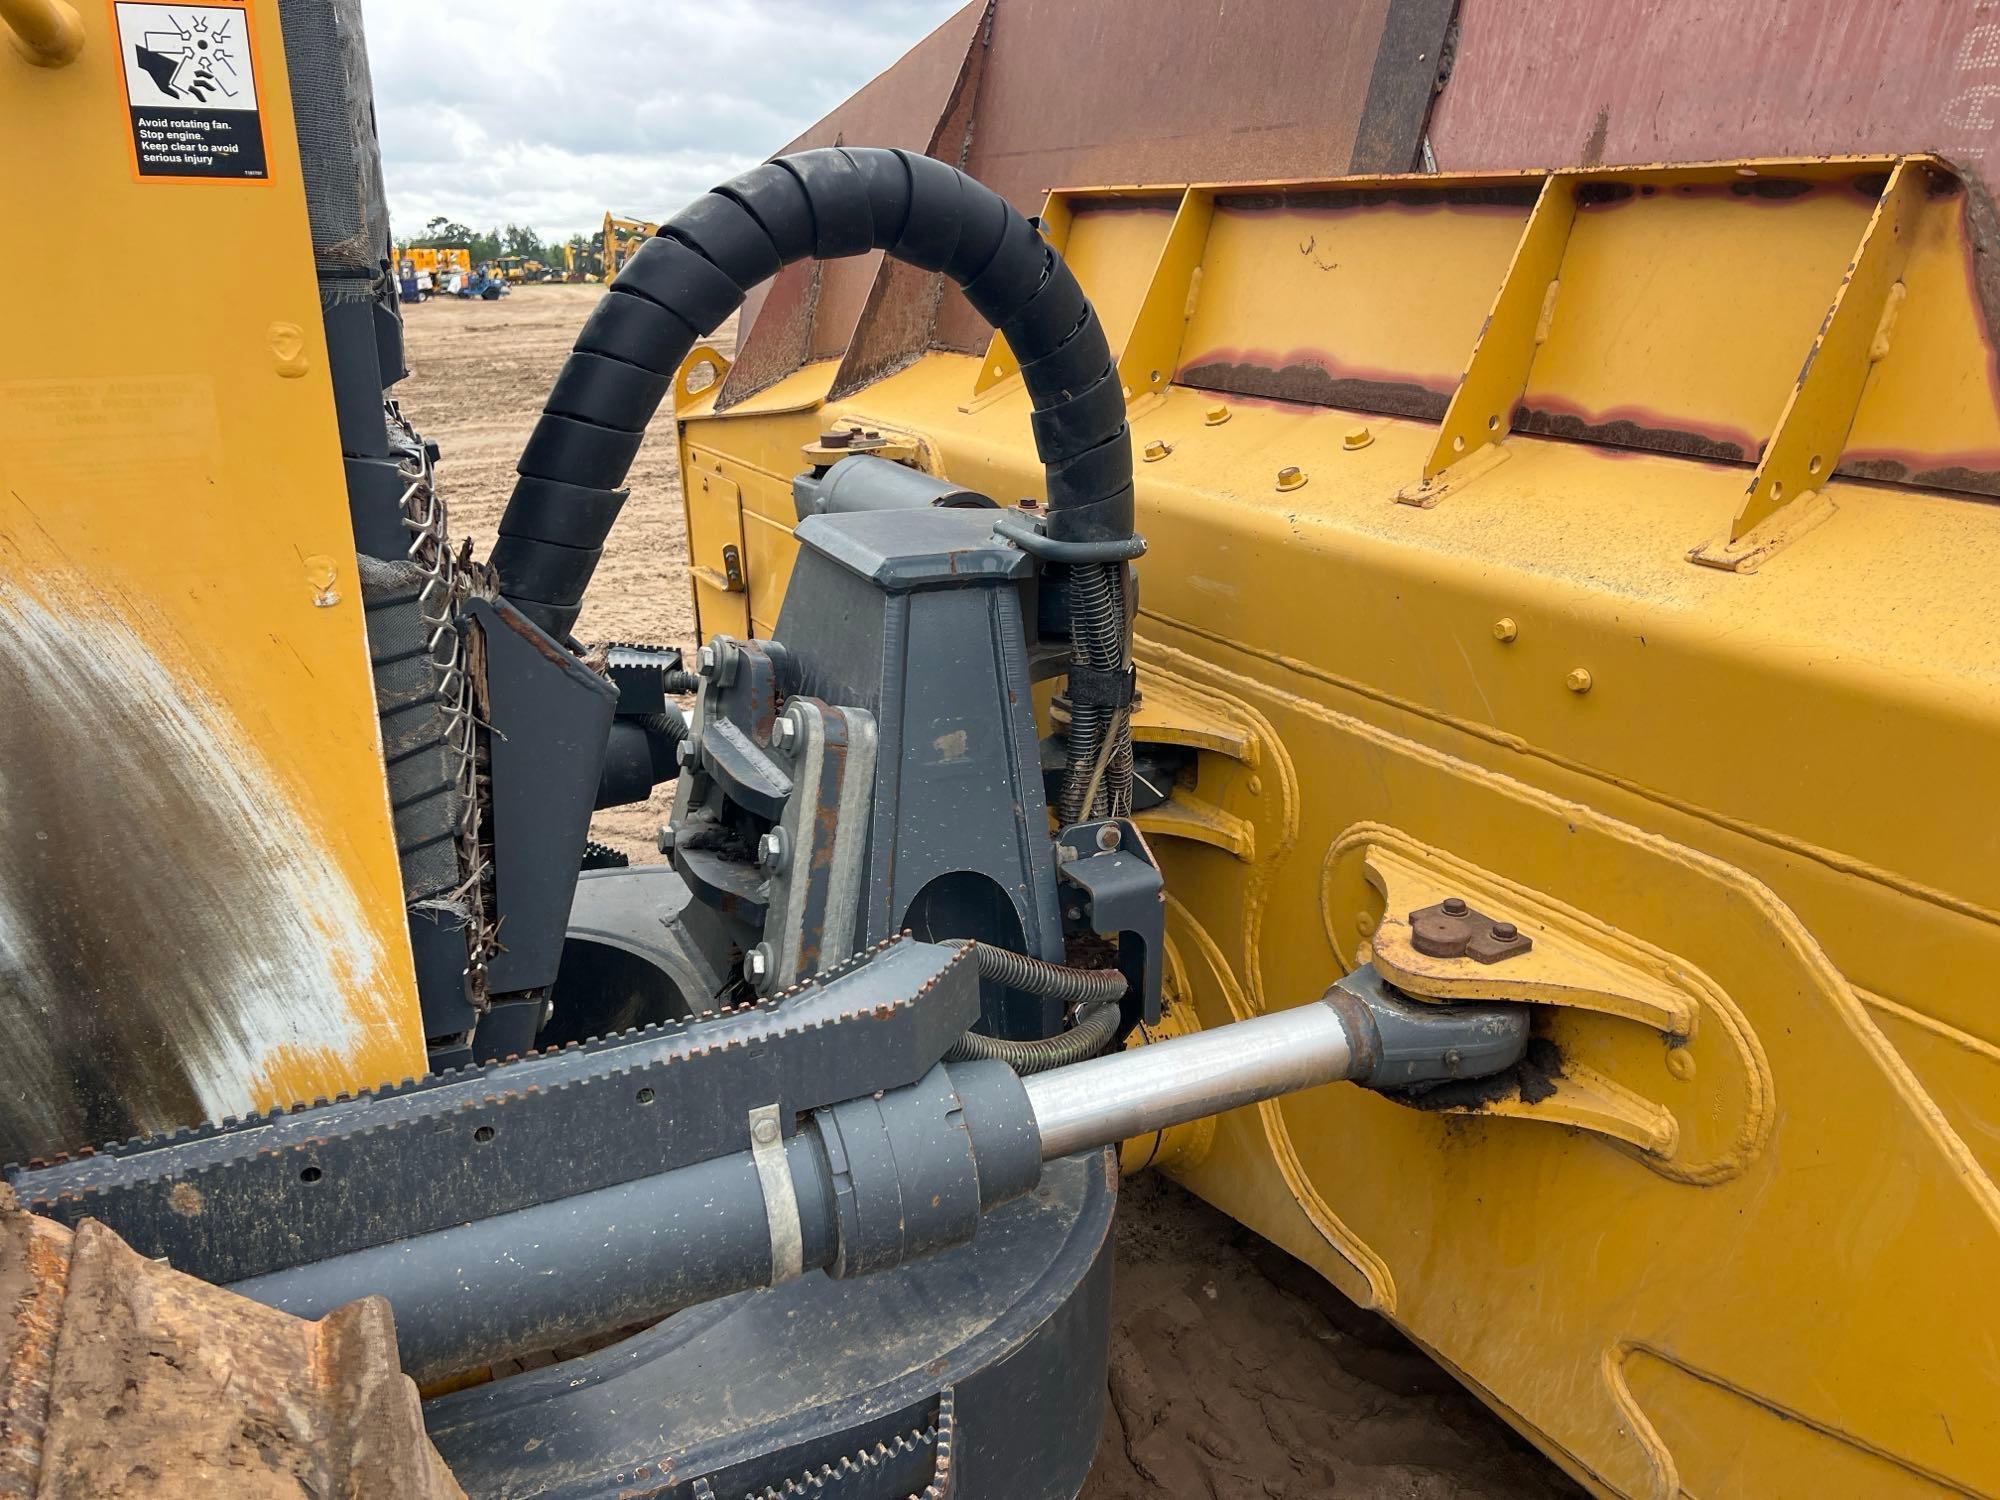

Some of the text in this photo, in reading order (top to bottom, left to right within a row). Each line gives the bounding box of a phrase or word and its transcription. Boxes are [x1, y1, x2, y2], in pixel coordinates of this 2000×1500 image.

[138, 118, 232, 131] Avoid rotating fan.
[140, 129, 204, 141] Stop engine.
[141, 141, 239, 153] Keep clear to avoid
[143, 153, 213, 165] serious injury
